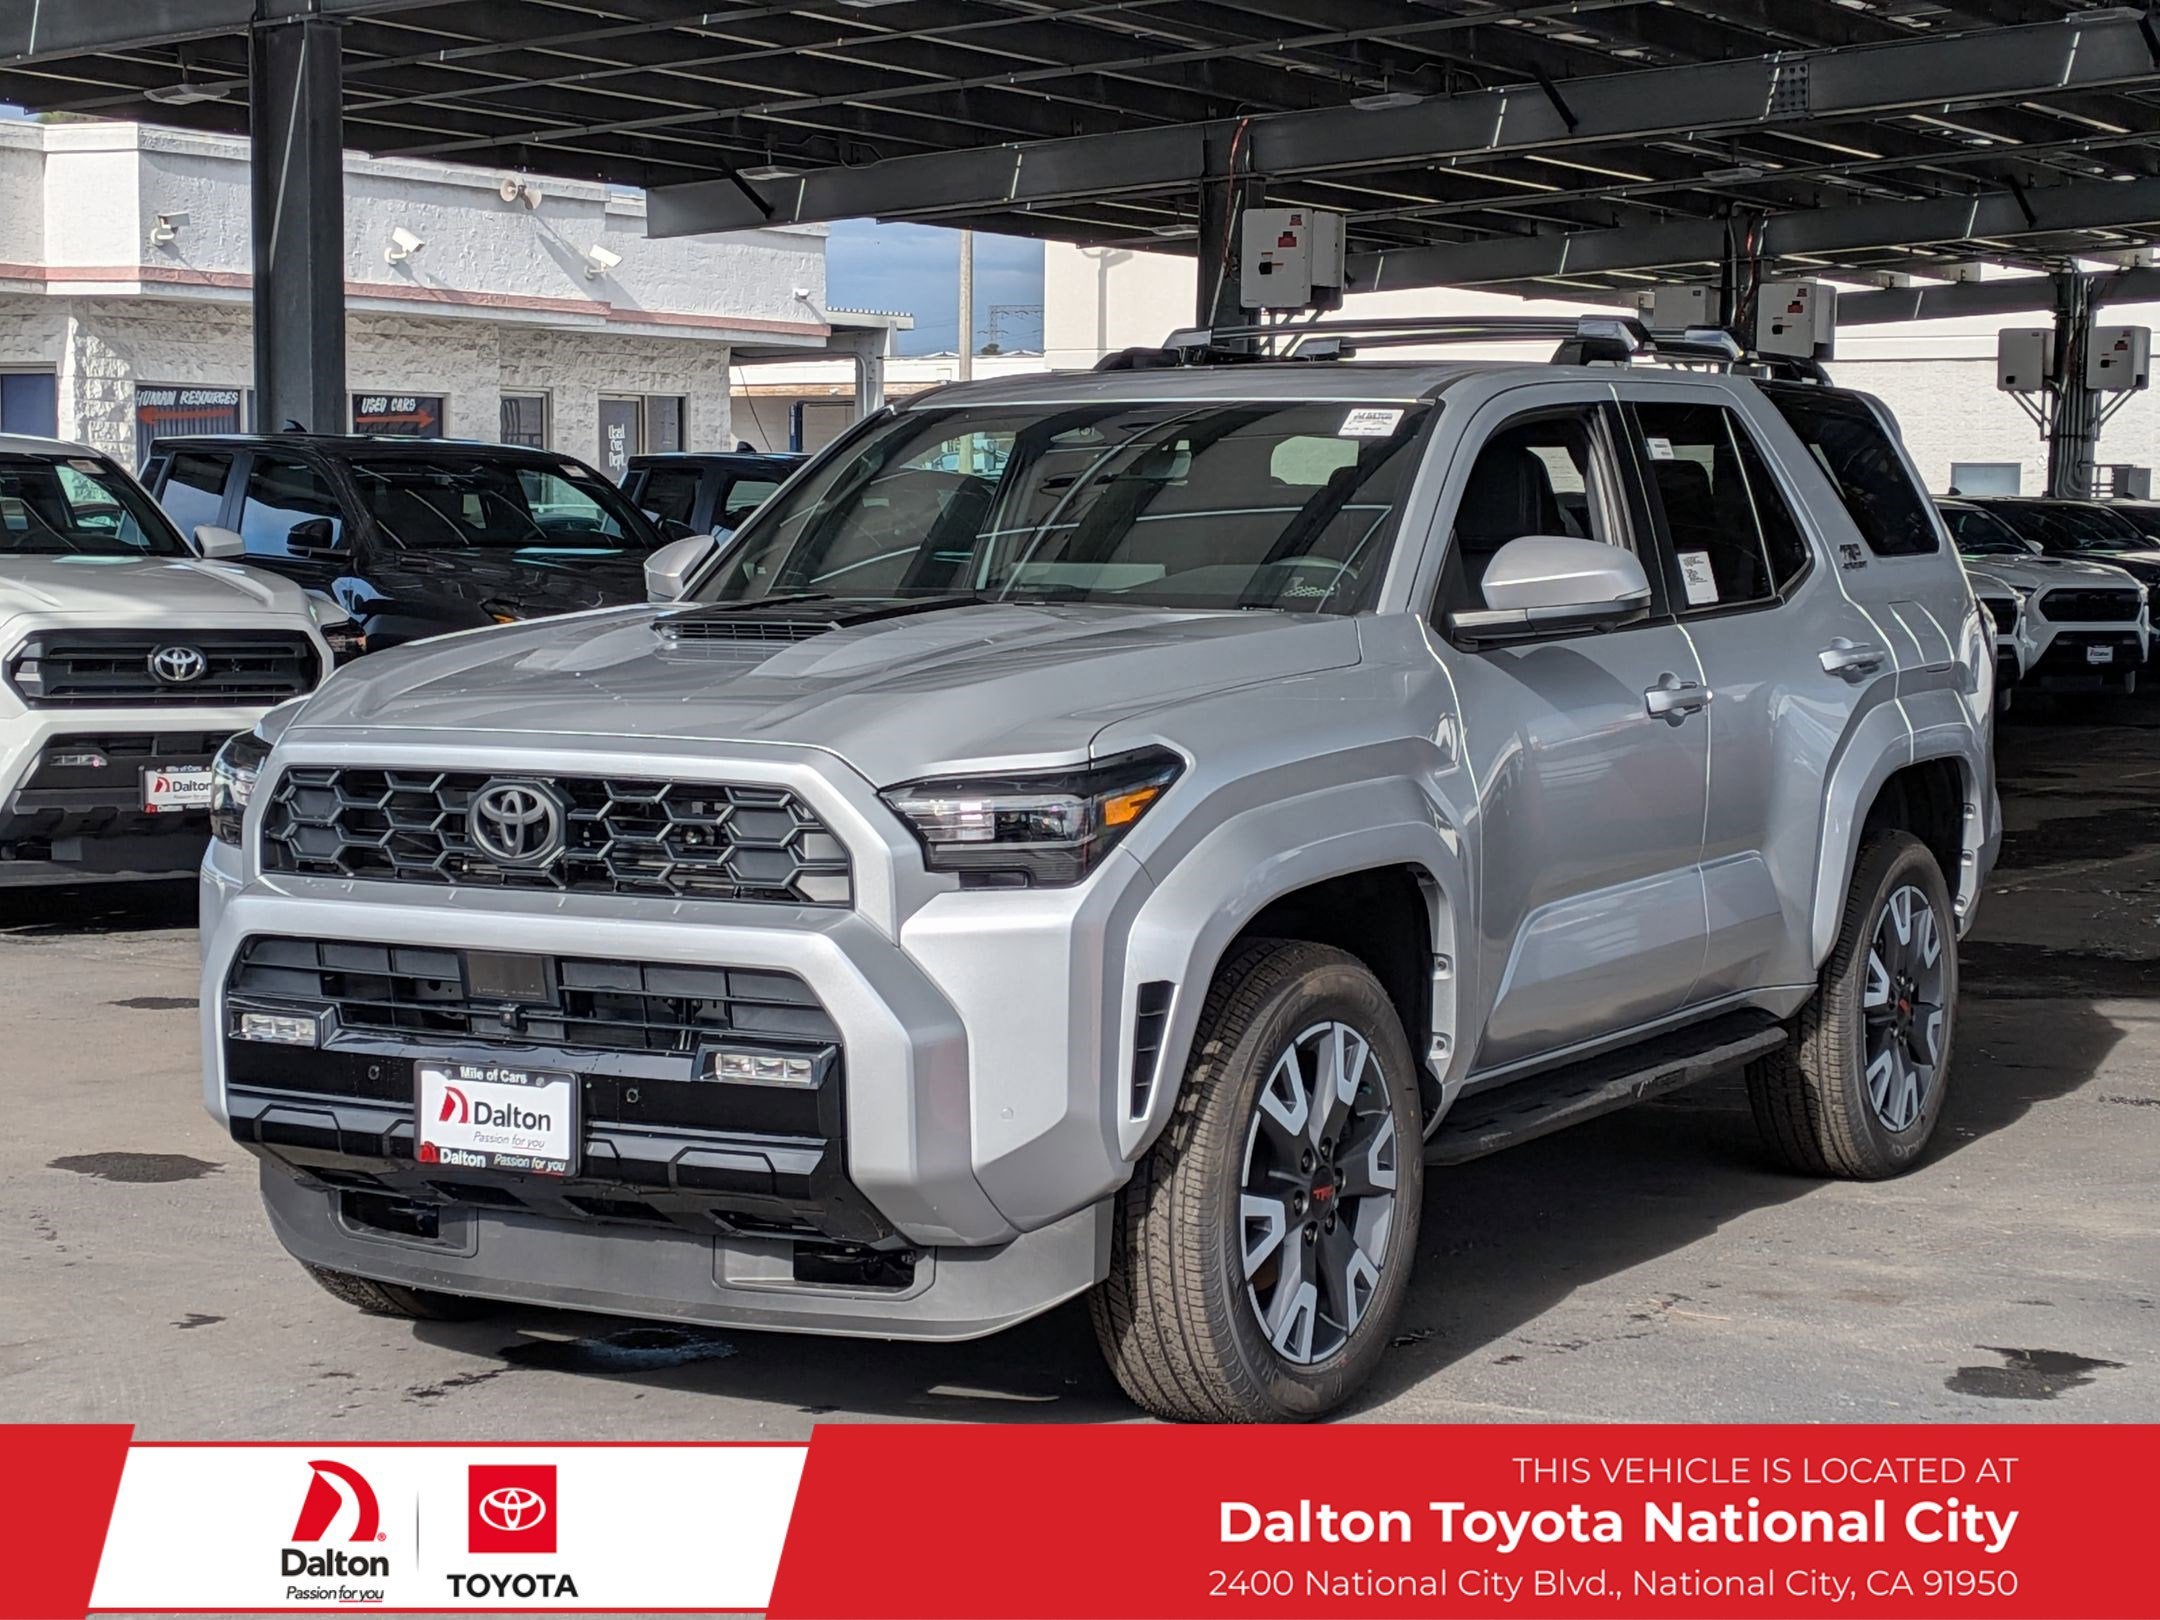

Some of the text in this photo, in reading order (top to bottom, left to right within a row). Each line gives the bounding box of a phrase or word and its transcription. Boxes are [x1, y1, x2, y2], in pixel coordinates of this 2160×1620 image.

[137, 390, 239, 406] HUMAN RESOURCES
[361, 397, 416, 413] USED CARS
[459, 1066, 528, 1084] Mile of Cars
[474, 1101, 552, 1132] Dalton
[473, 1131, 546, 1149] Passion for you
[440, 1148, 567, 1172] Dalton Passion for you
